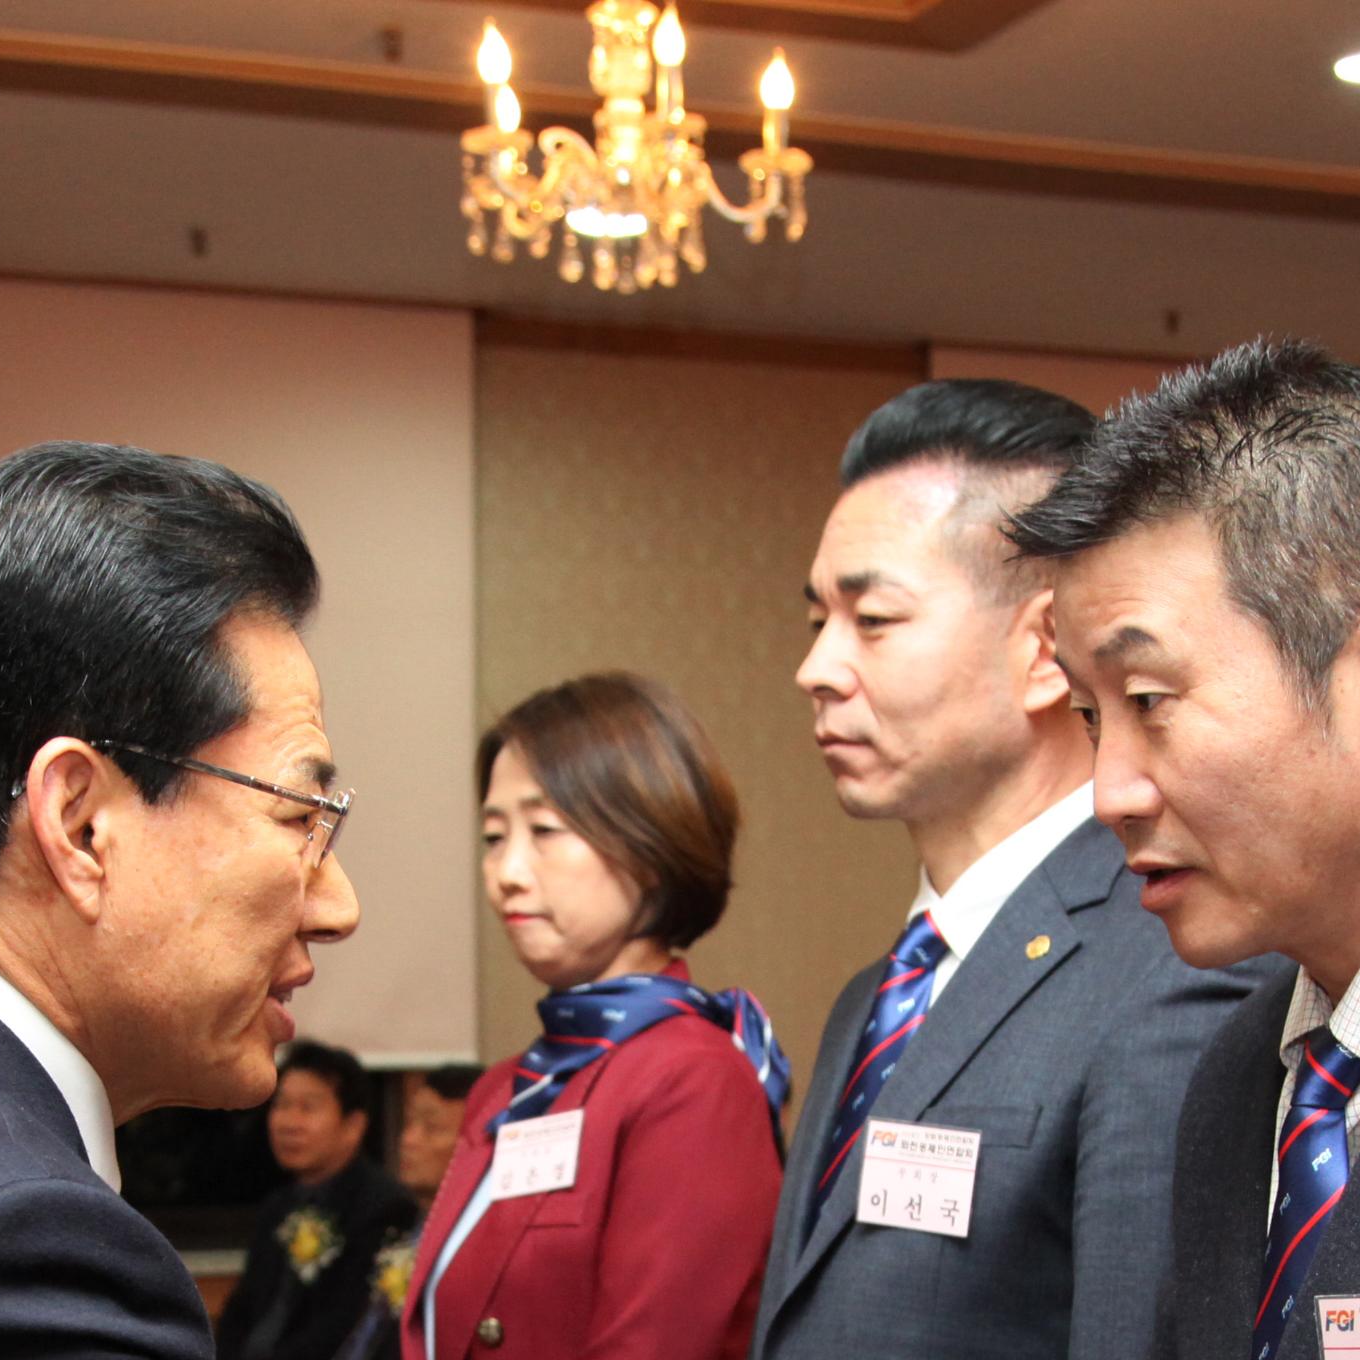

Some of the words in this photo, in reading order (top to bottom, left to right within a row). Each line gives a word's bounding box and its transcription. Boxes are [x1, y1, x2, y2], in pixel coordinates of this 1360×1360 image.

[870, 1189, 888, 1217] 이
[904, 1193, 922, 1222] 선
[939, 1198, 960, 1227] 국
[1326, 1310, 1355, 1332] FGI
